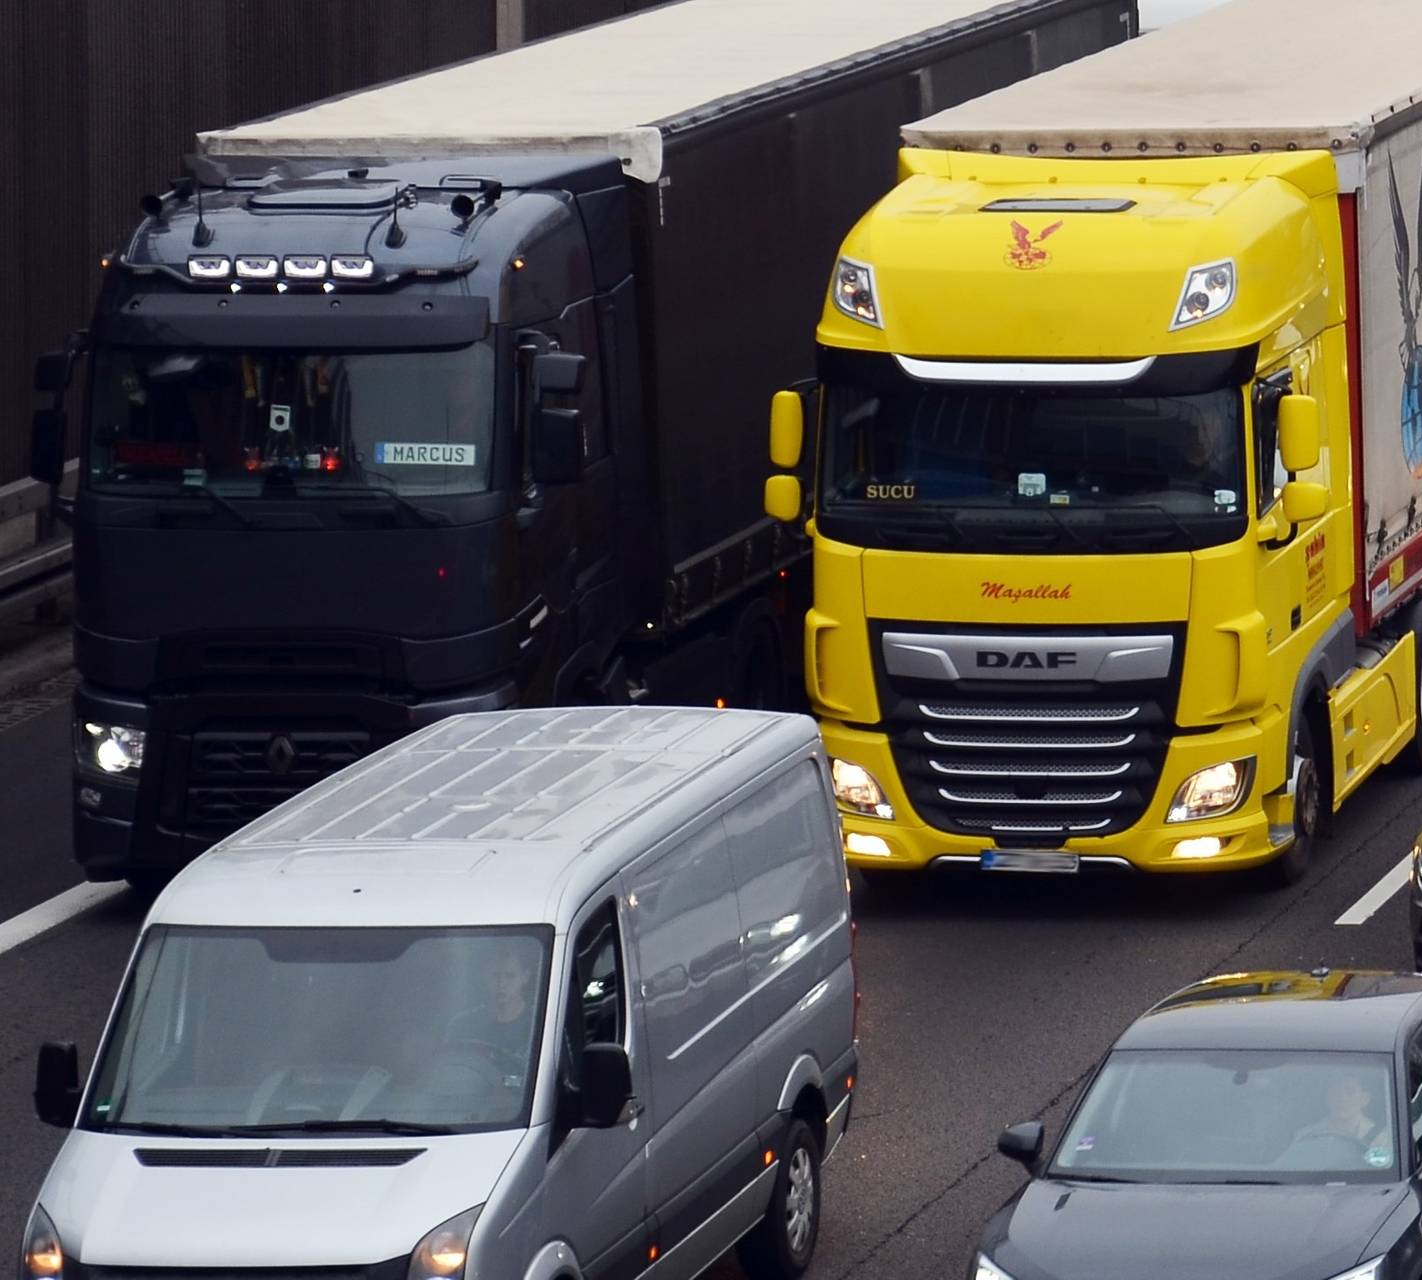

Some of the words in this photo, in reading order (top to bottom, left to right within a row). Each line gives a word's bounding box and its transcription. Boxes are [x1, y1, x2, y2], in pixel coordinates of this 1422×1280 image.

[393, 446, 465, 463] MARCUS
[866, 484, 915, 499] SUCU
[976, 650, 1077, 669] DAF
